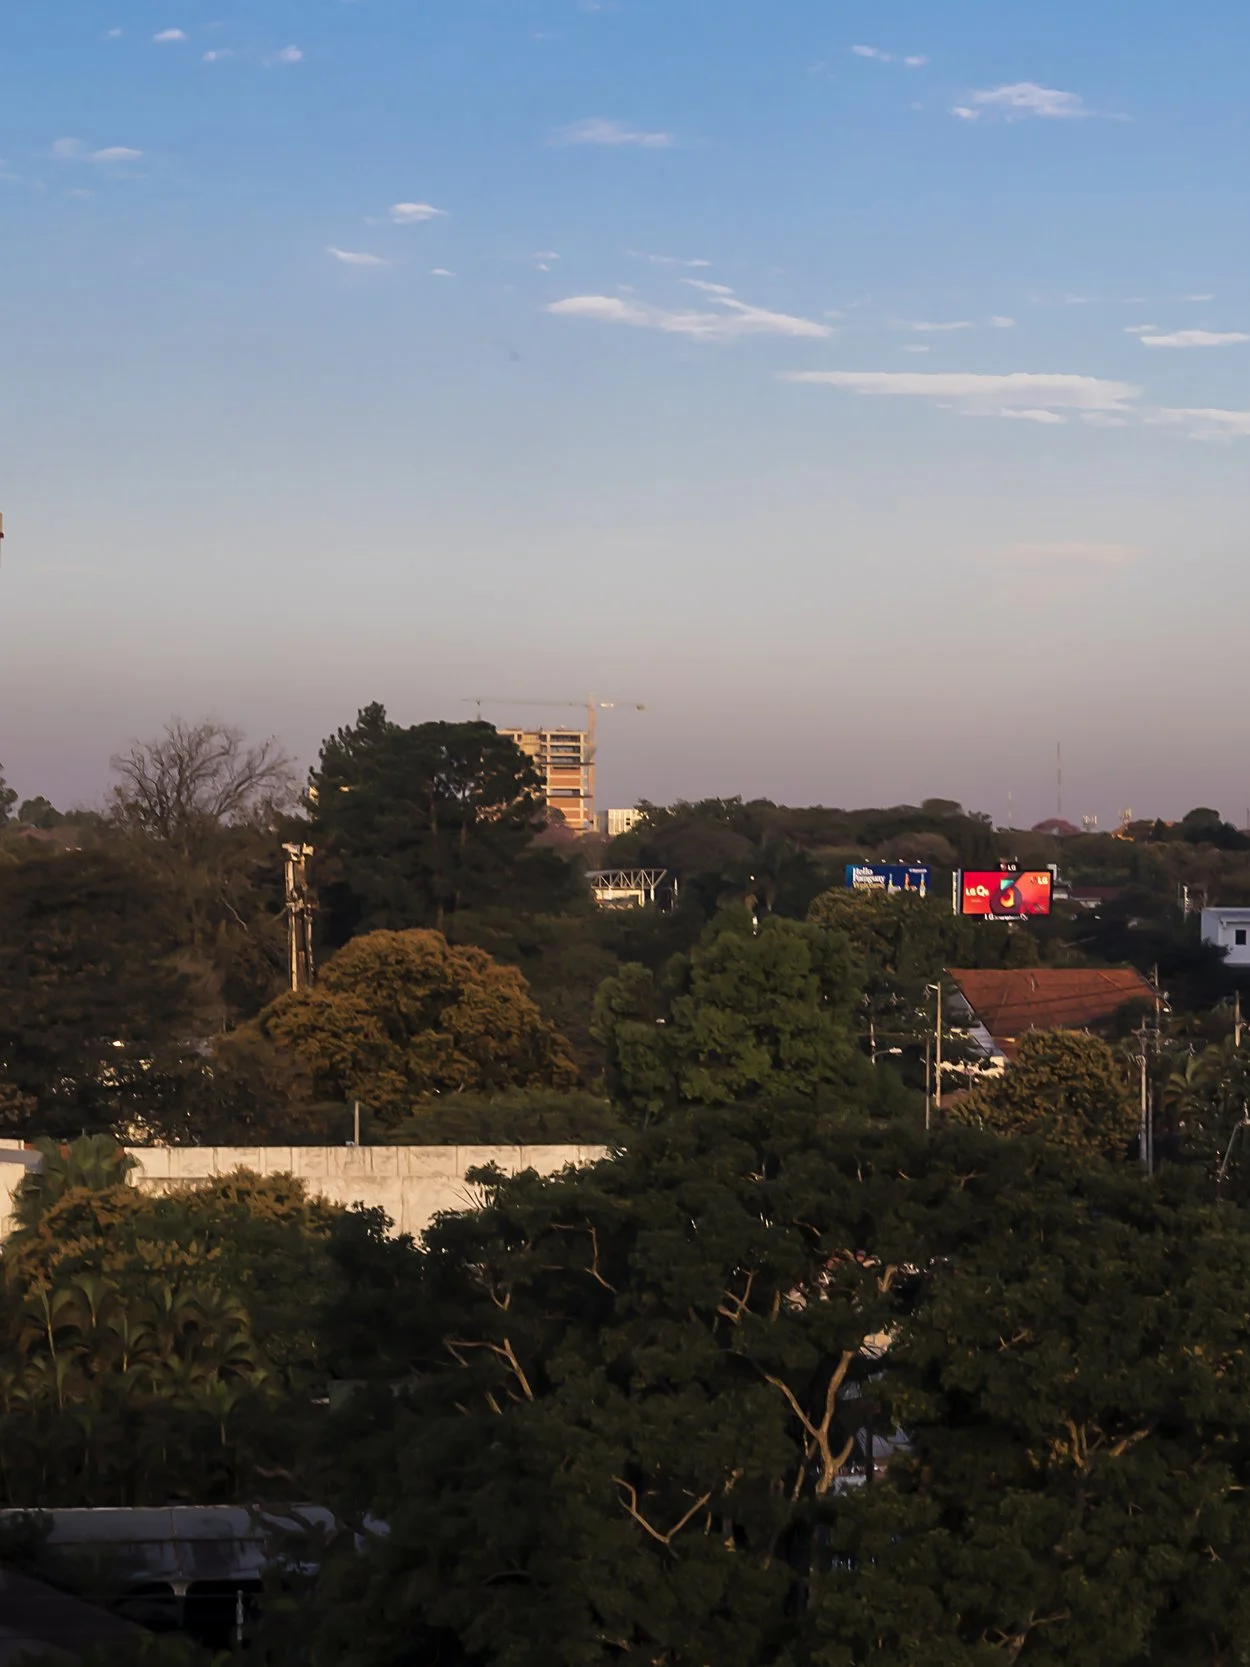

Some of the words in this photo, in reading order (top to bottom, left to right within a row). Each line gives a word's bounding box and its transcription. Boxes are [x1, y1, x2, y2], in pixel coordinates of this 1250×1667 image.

[853, 867, 873, 875] Hello
[1038, 876, 1048, 885] LG
[965, 888, 976, 896] LG
